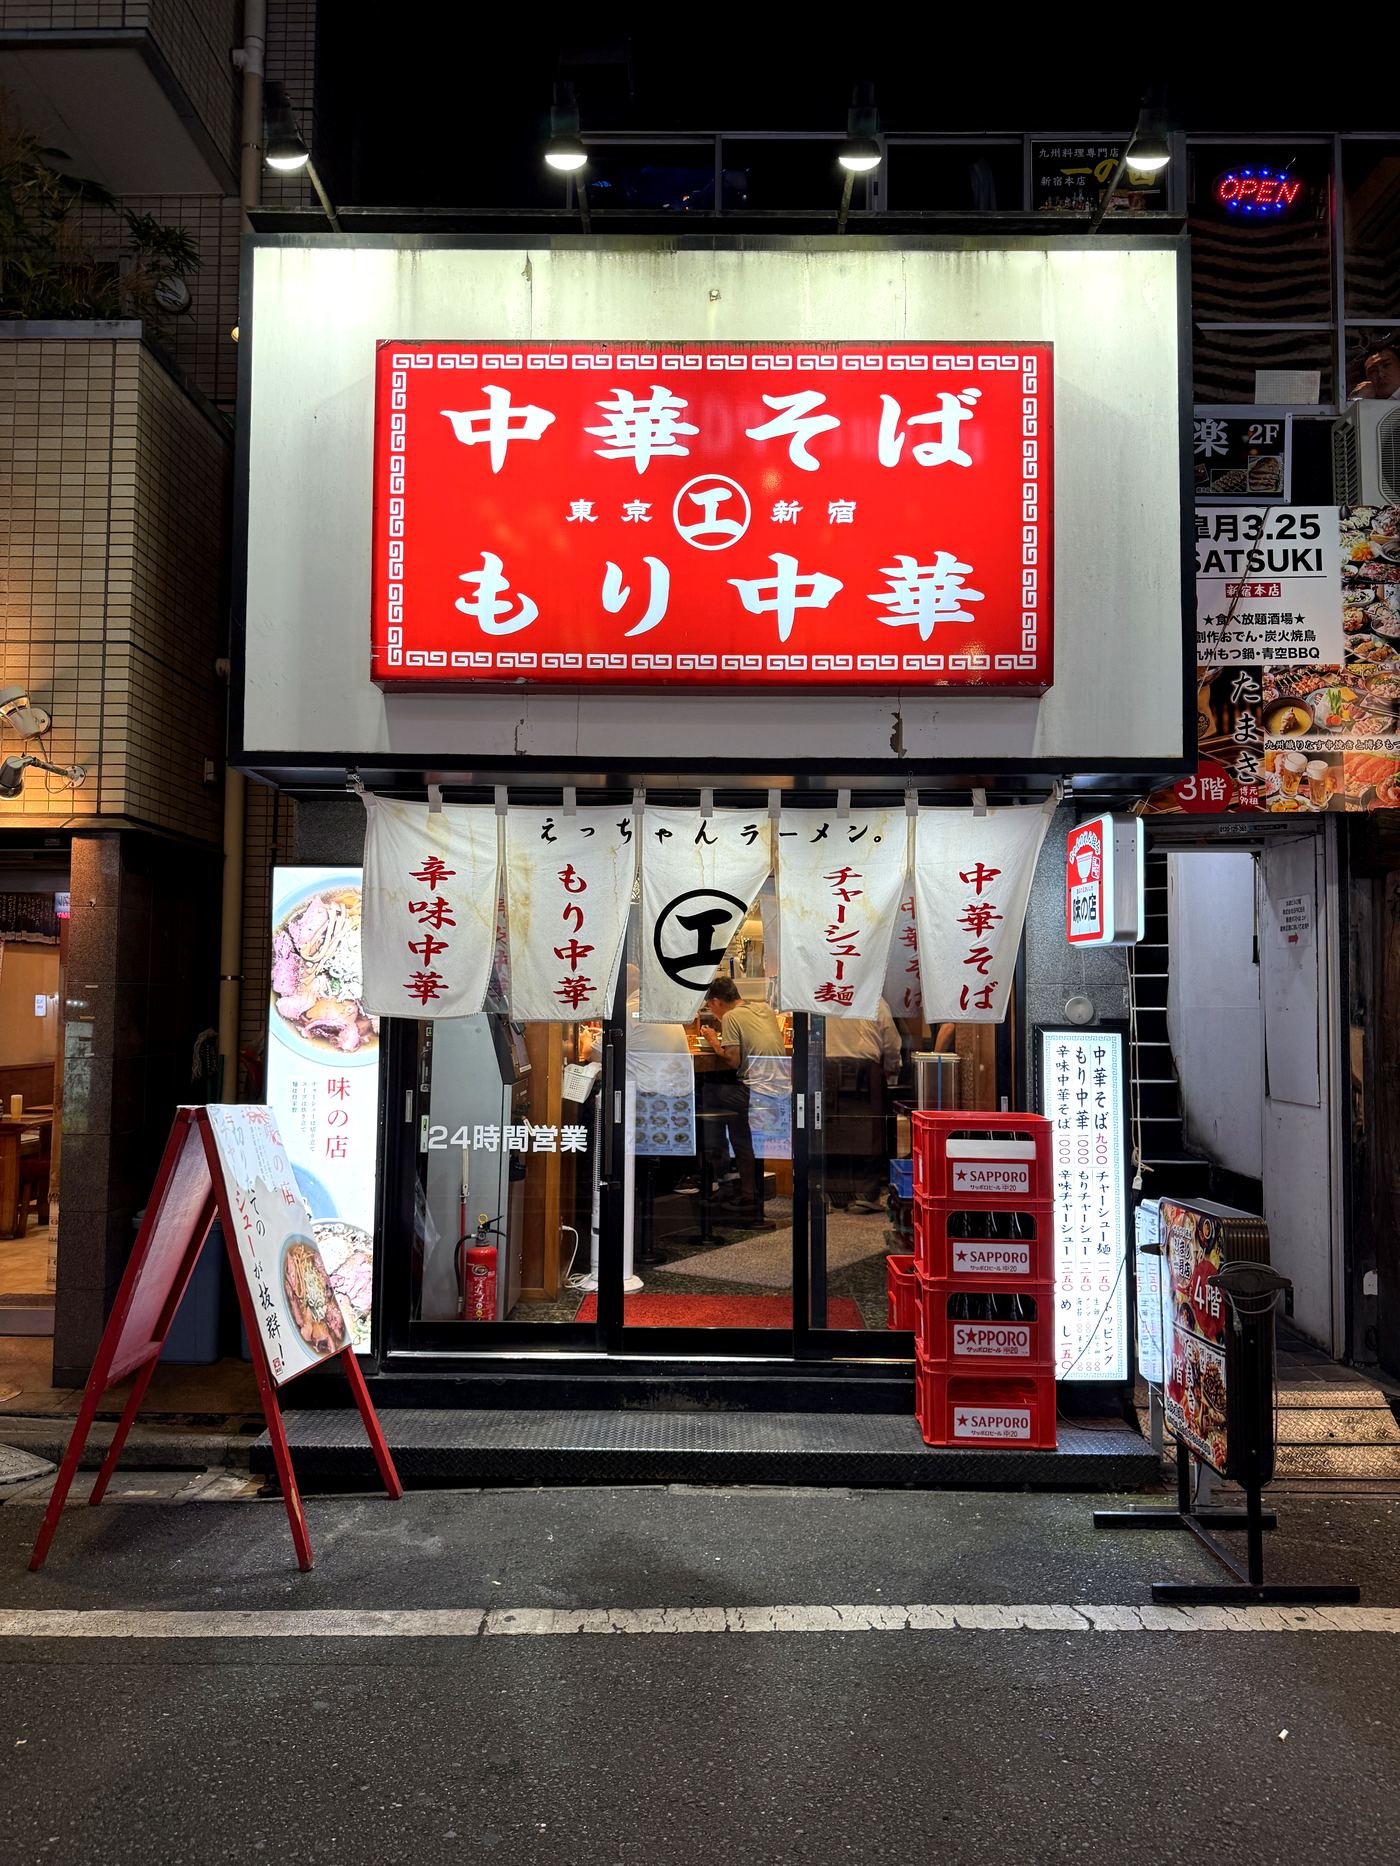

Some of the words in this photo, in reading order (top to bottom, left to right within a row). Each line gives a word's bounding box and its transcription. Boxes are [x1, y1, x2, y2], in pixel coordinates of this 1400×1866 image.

[1220, 178, 1300, 203] OPEN
[440, 384, 982, 474] 中華そば
[1247, 424, 1279, 445] 2F
[565, 499, 653, 524] 東京
[771, 500, 856, 524] 新宿
[454, 551, 985, 642] もり中華
[1226, 584, 1280, 597] 新宿本店
[1231, 670, 1261, 785] たまき
[1178, 775, 1227, 801] 3階
[403, 855, 457, 1006] 辛味中華
[553, 863, 597, 1010] もり中華
[813, 866, 864, 1007] チャーシュー麺
[955, 862, 1004, 1011] 中華そば
[325, 1077, 351, 1159] 味の店
[1056, 1045, 1071, 1130] 辛味中華そば
[1075, 1047, 1089, 1130] もり中華
[1093, 1046, 1109, 1130] 中華そば
[428, 1125, 589, 1153] 24時間営業
[970, 1170, 1027, 1183] SAPPORO
[1058, 1170, 1074, 1256] 辛味チャーシュー
[1078, 1170, 1092, 1256] もりチャーシュー
[970, 1251, 1028, 1263] SAPPORO
[1193, 1275, 1223, 1319] 4階
[1060, 1300, 1072, 1338] めし
[1103, 1302, 1114, 1366] トッピング
[971, 1416, 1028, 1429] SAPPORO
